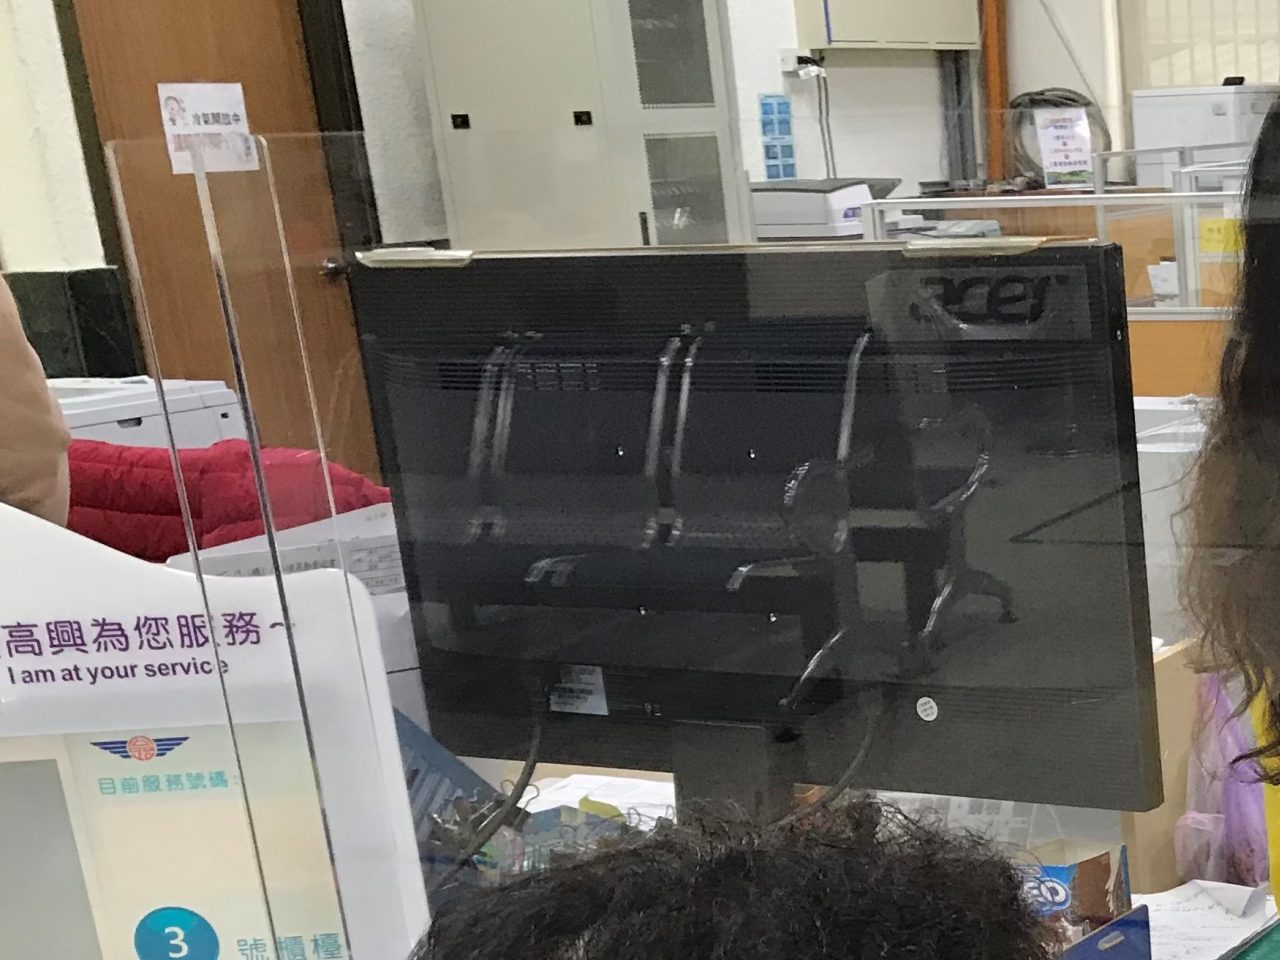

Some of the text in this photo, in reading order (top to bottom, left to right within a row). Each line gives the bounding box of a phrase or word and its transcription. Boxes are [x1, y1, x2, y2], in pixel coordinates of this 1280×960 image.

[908, 274, 1070, 325] acer
[7, 657, 229, 685] I am at your service
[163, 926, 189, 959] 3
